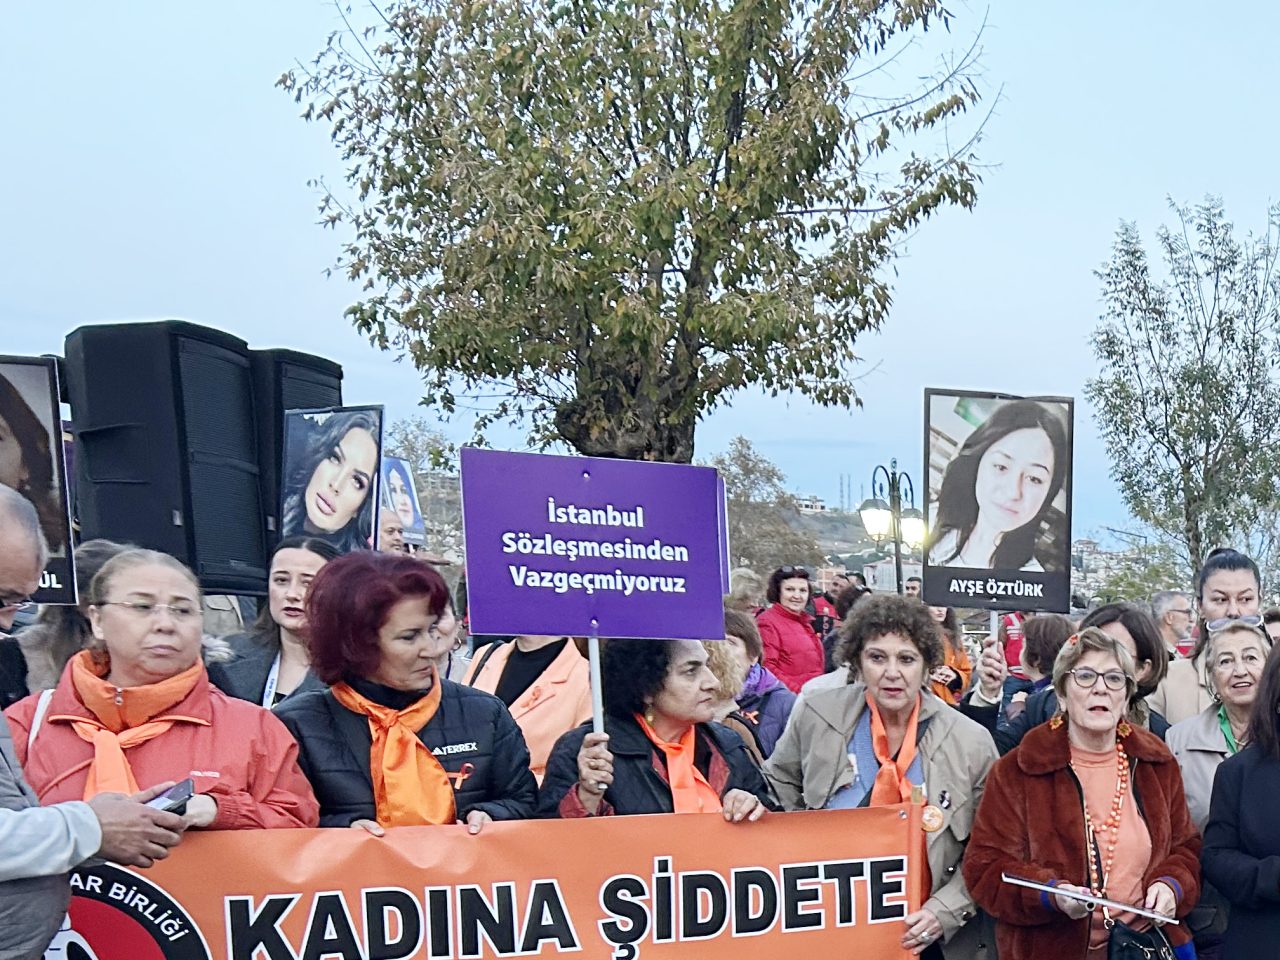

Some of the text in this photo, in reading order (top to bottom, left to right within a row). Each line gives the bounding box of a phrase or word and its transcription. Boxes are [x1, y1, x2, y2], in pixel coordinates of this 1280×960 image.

[547, 496, 645, 528] İstanbul
[501, 531, 690, 562] Sözleşmesinden
[39, 570, 63, 588] ÜL
[508, 564, 687, 596] Vazgeçmiyoruz
[949, 578, 1043, 597] AYŞE ÖZTÜRK
[442, 742, 478, 755] TERREX
[108, 882, 189, 942] BİRLİĞİ
